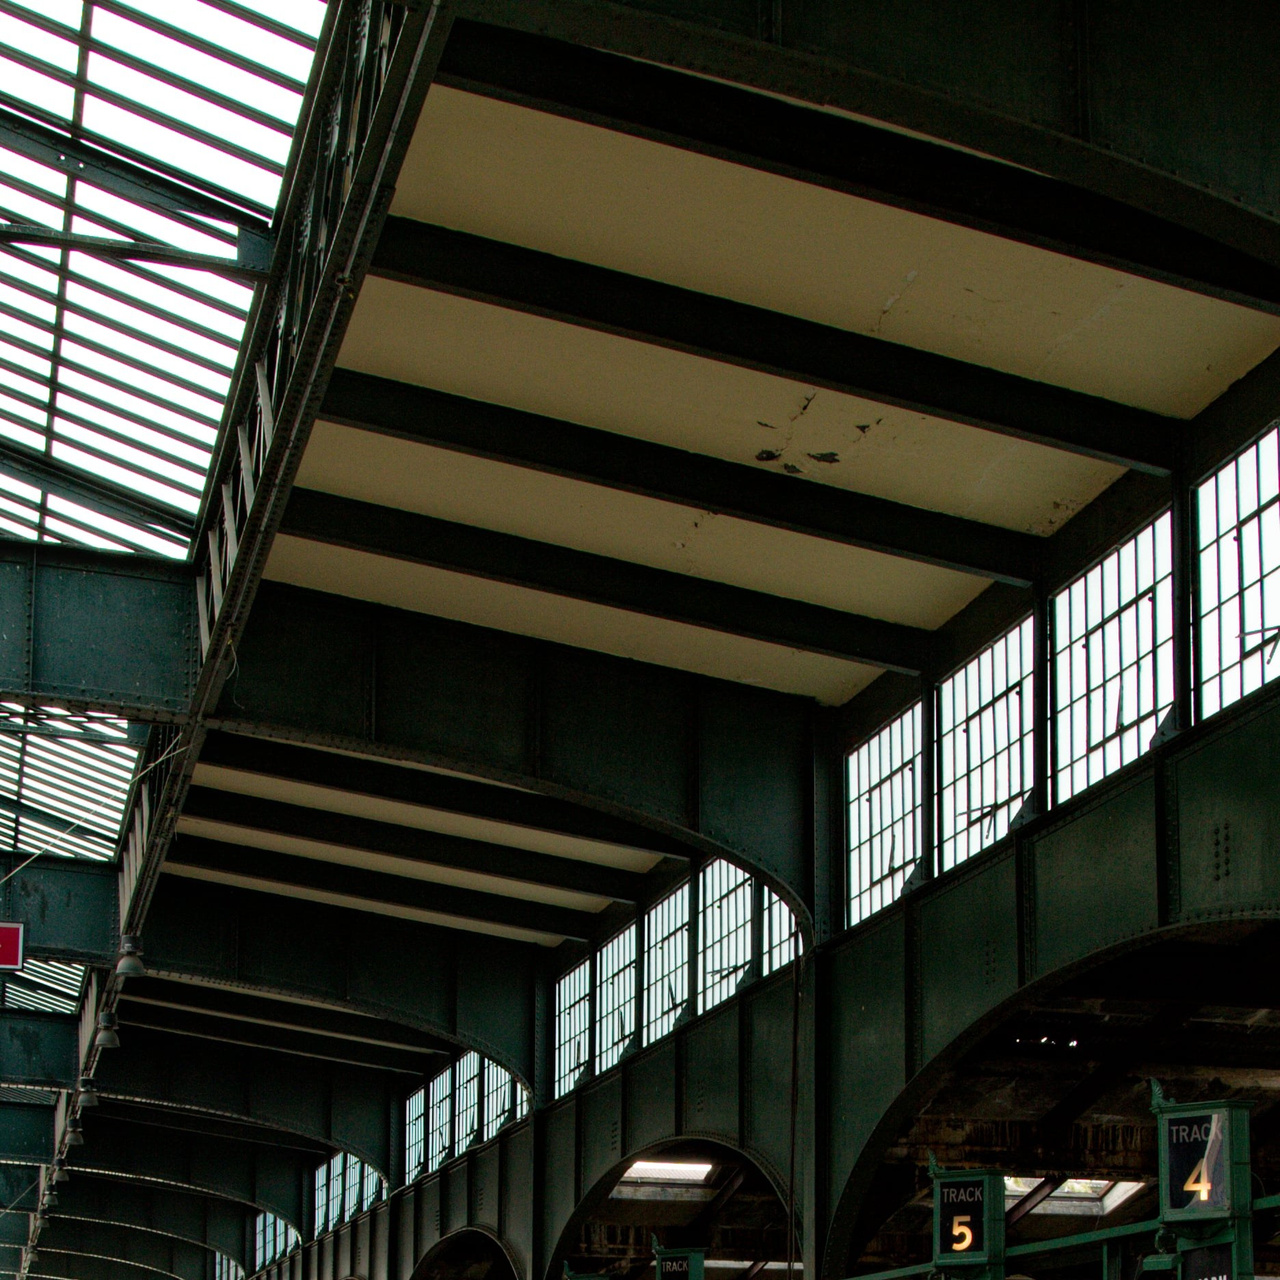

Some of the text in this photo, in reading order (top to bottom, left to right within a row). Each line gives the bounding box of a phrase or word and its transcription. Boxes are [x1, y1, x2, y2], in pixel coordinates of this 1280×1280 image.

[1170, 1122, 1223, 1144] TRACK
[1183, 1157, 1212, 1201] 4
[942, 1186, 983, 1203] TRACK
[951, 1214, 973, 1252] 5
[661, 1260, 688, 1272] TRACK
